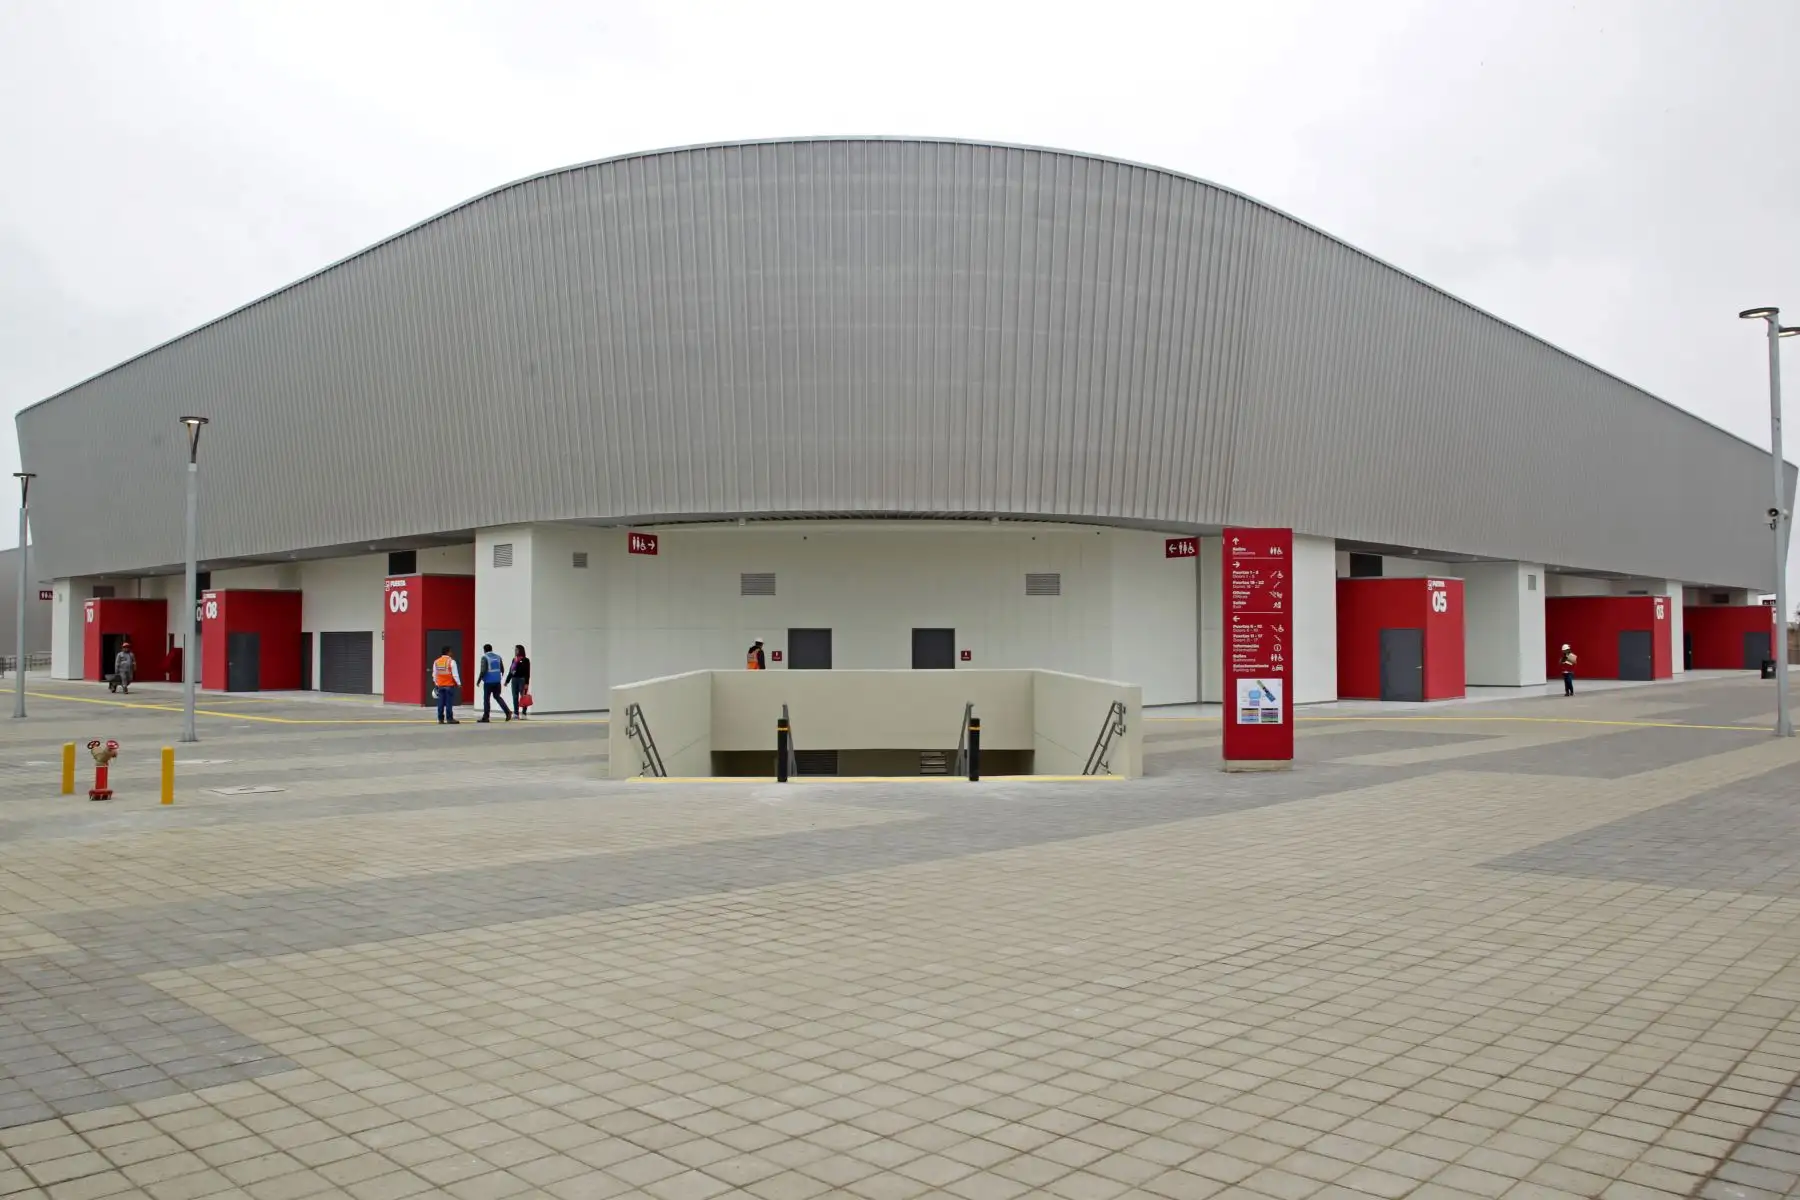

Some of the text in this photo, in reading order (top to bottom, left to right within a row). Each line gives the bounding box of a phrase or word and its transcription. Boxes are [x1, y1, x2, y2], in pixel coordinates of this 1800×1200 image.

[206, 602, 217, 618] 08
[390, 590, 408, 612] 06
[1432, 591, 1447, 612] 05
[86, 608, 94, 622] 10
